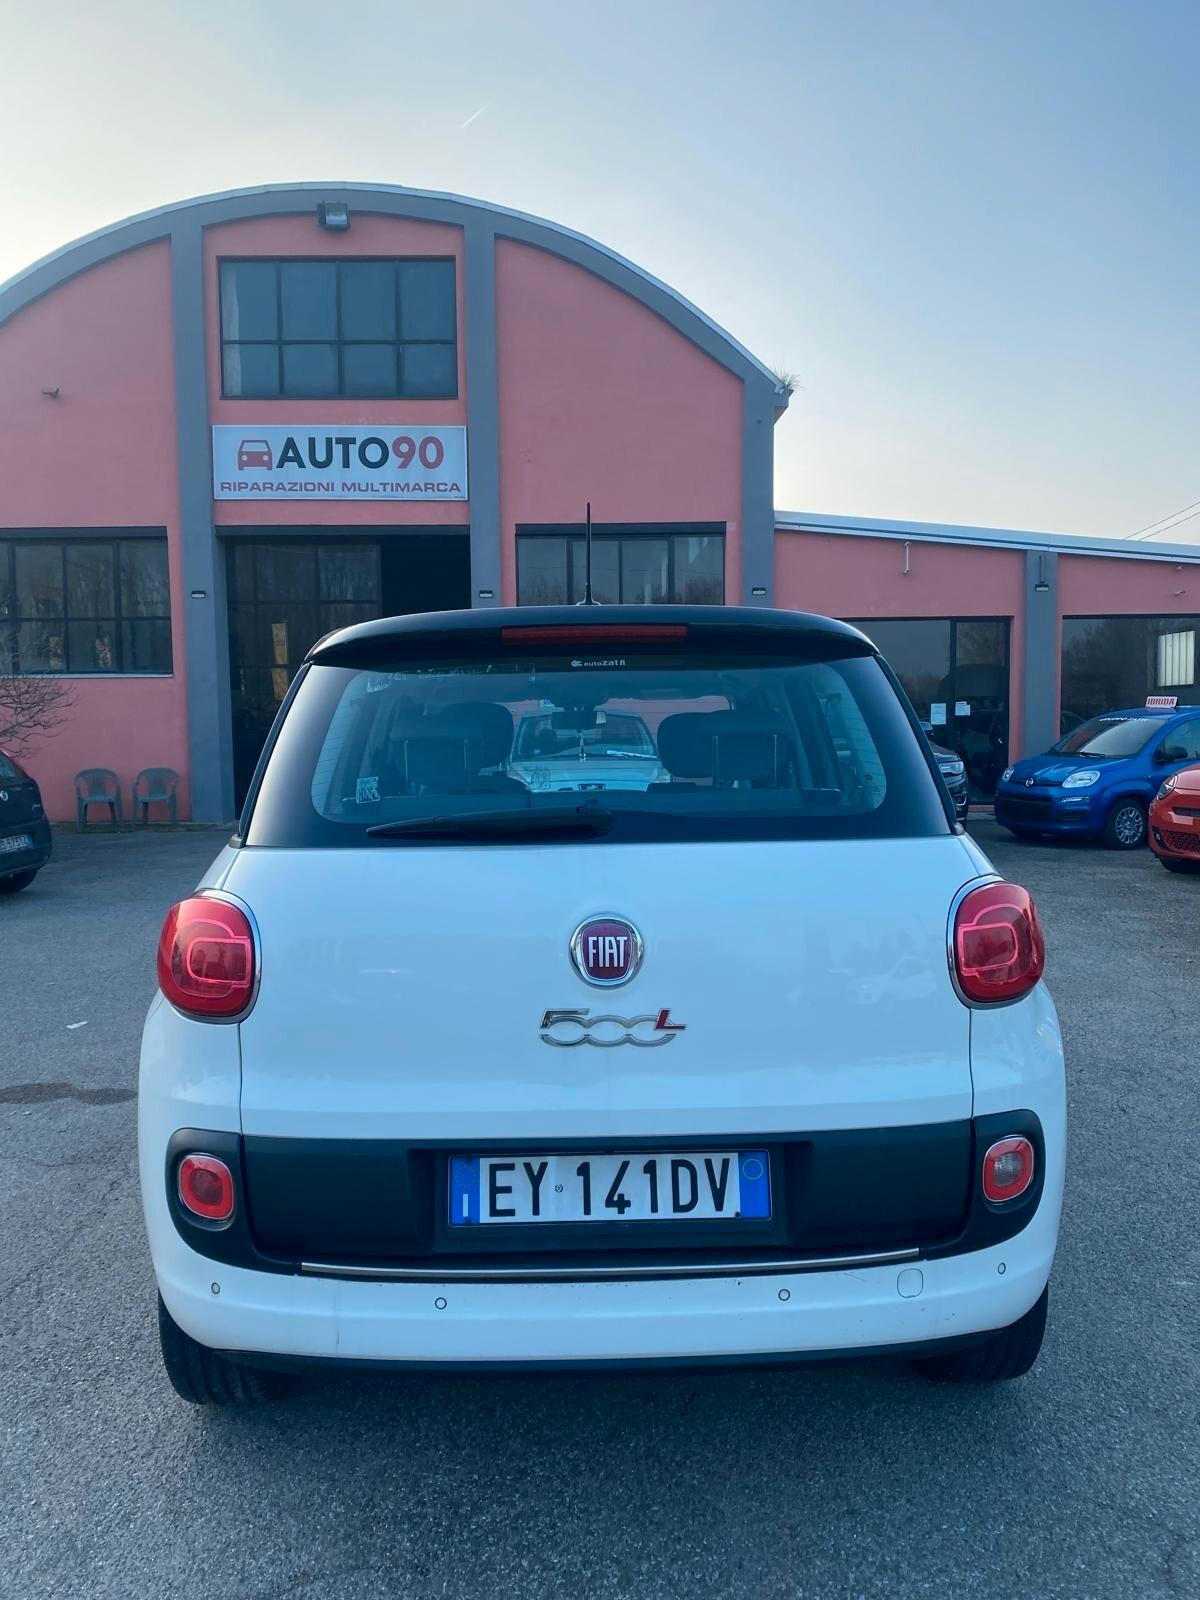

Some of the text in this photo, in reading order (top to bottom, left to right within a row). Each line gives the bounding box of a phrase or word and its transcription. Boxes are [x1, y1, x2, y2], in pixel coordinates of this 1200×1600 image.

[276, 436, 444, 469] AUTO90
[220, 481, 462, 493] RIPARAZIONI MULTIMARCA
[1147, 697, 1175, 706] IBRIDA
[588, 936, 627, 968] FIAT
[488, 1157, 731, 1218] EY 141DV
